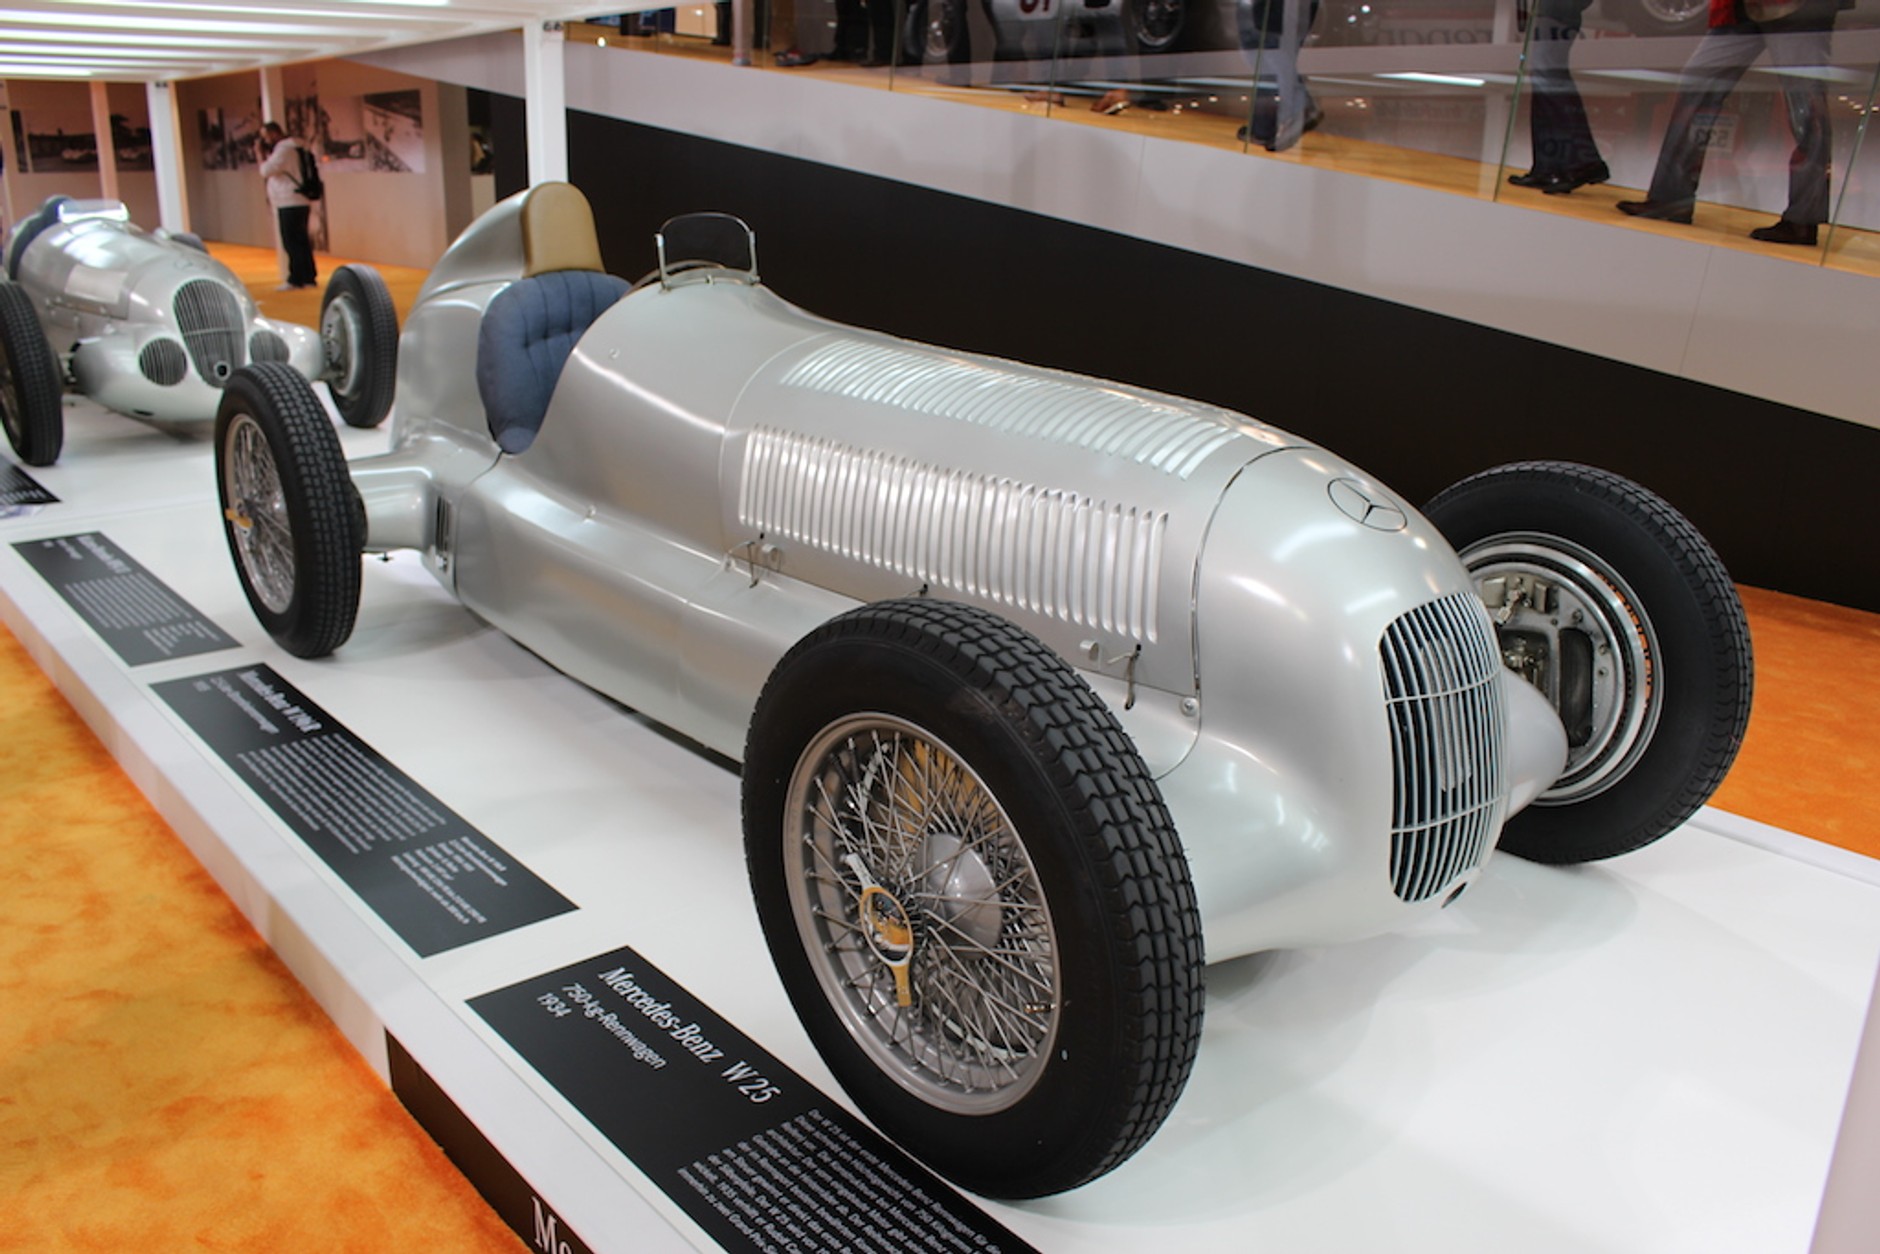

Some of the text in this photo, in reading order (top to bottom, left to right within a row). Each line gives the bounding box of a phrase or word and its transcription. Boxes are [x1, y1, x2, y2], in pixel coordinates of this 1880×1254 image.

[537, 992, 573, 1018] 1934
[562, 983, 668, 1071] 750-kg-Rennwagen
[598, 967, 725, 1064] Mercedes-Benz
